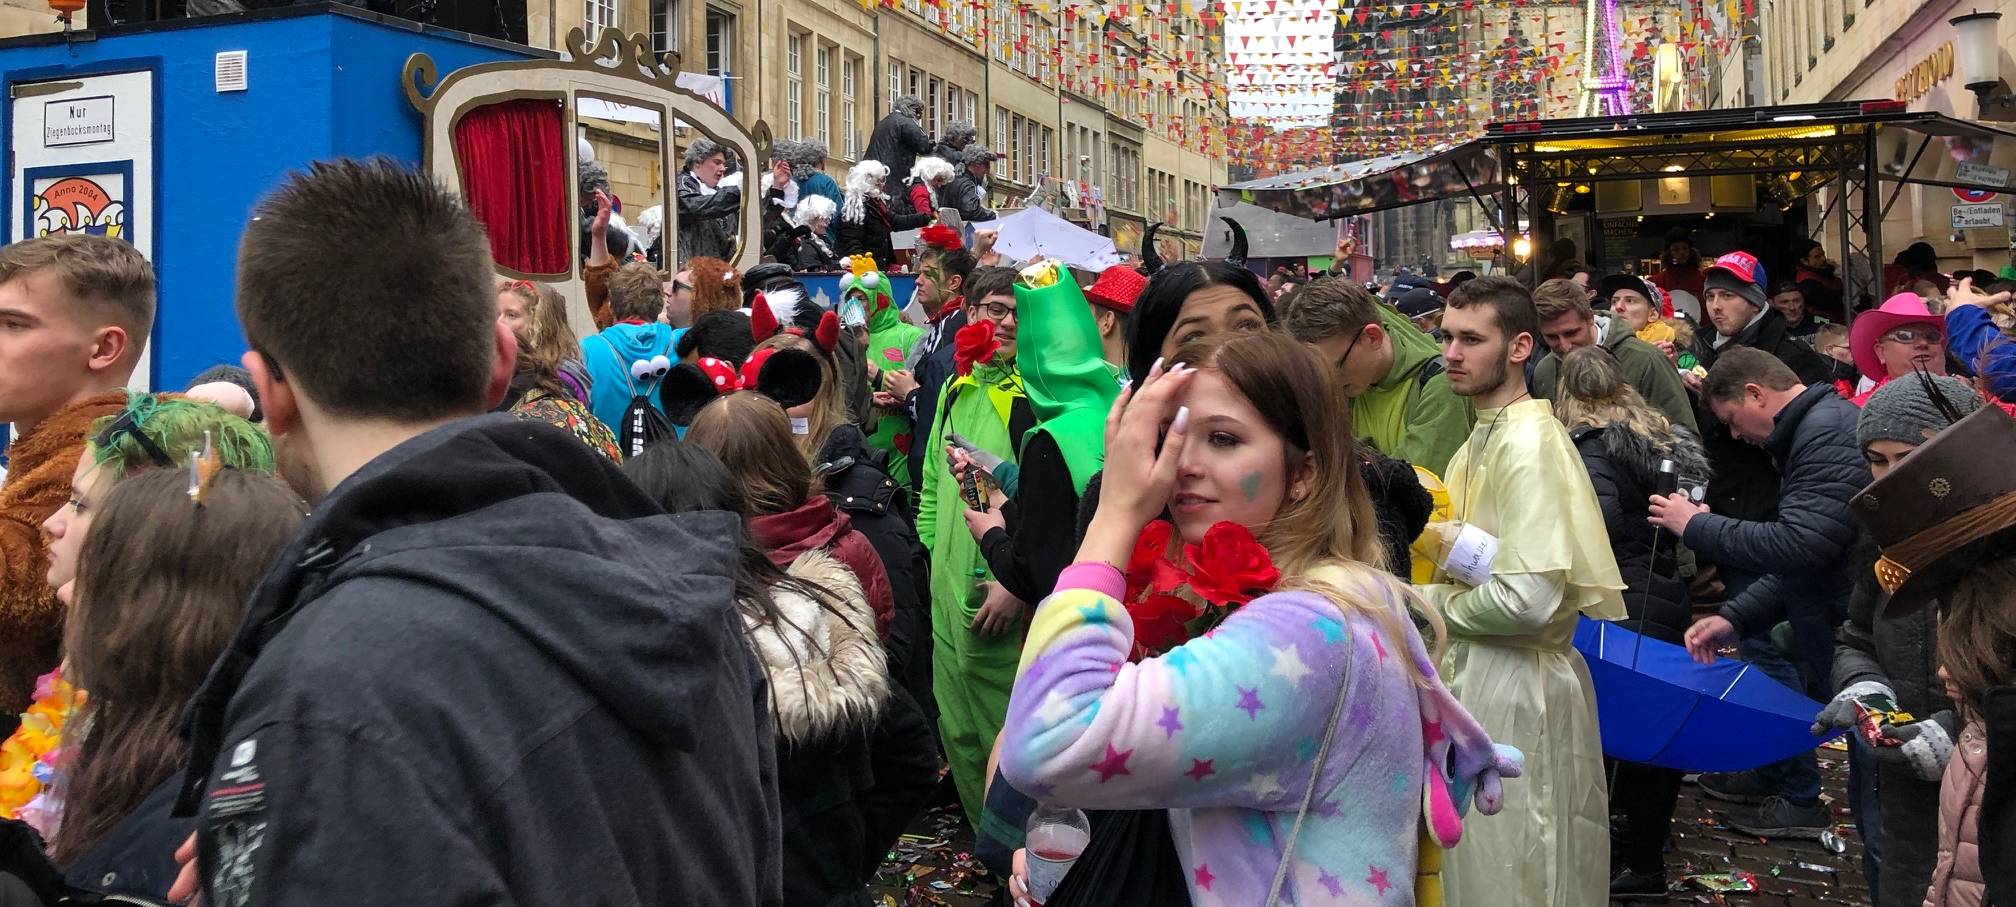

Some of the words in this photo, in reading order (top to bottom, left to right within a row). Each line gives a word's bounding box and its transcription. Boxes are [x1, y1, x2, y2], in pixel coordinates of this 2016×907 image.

[69, 105, 86, 119] Nur
[46, 123, 111, 139] Ziegenbocksmontag
[54, 186, 77, 199] Anno
[78, 184, 98, 202] 2004
[1964, 217, 1991, 225] erlaubt
